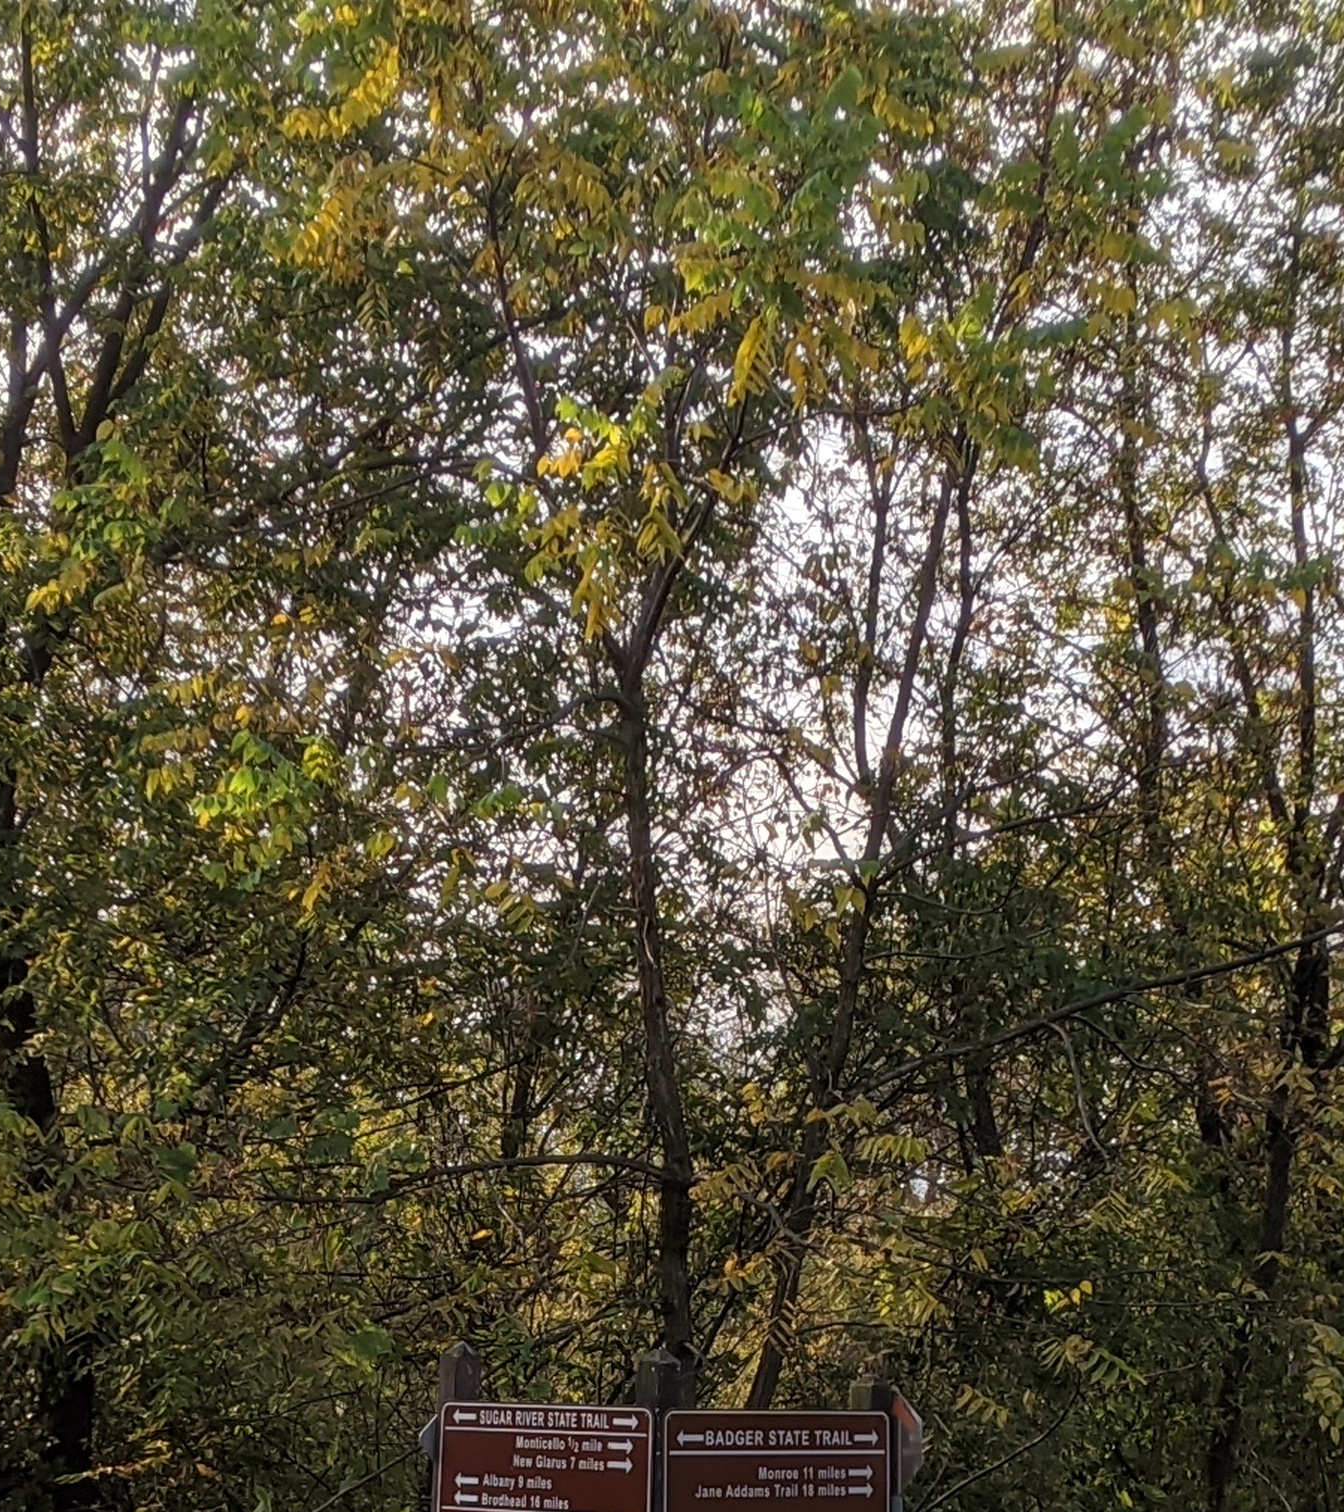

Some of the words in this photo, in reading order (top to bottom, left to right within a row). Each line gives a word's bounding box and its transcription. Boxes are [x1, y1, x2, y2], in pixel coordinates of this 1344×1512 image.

[480, 1410, 513, 1425] SUGAR
[515, 1411, 544, 1426] RIVER
[548, 1412, 577, 1428] STATE
[581, 1413, 609, 1429] TRAIL
[516, 1436, 565, 1451] Monticello
[582, 1439, 602, 1451] mile
[705, 1431, 764, 1446] BADGER
[769, 1431, 809, 1446] STATE
[814, 1431, 852, 1445] TRAIL
[513, 1455, 532, 1467] New
[535, 1455, 567, 1469] Glarus
[570, 1457, 575, 1469] 7
[579, 1458, 604, 1471] miles
[758, 1467, 799, 1480] Monroe
[803, 1467, 813, 1479] 11
[818, 1466, 846, 1479] miles
[483, 1474, 515, 1490] Albany
[518, 1476, 523, 1488] 9
[526, 1477, 552, 1489] miles
[695, 1485, 722, 1498] Jane
[726, 1485, 770, 1497] Addams
[774, 1485, 798, 1497] Trail
[802, 1485, 814, 1496] 18
[818, 1484, 846, 1496] miles
[482, 1493, 526, 1508] Brodhead
[530, 1496, 540, 1508] 16
[544, 1497, 569, 1510] miles
